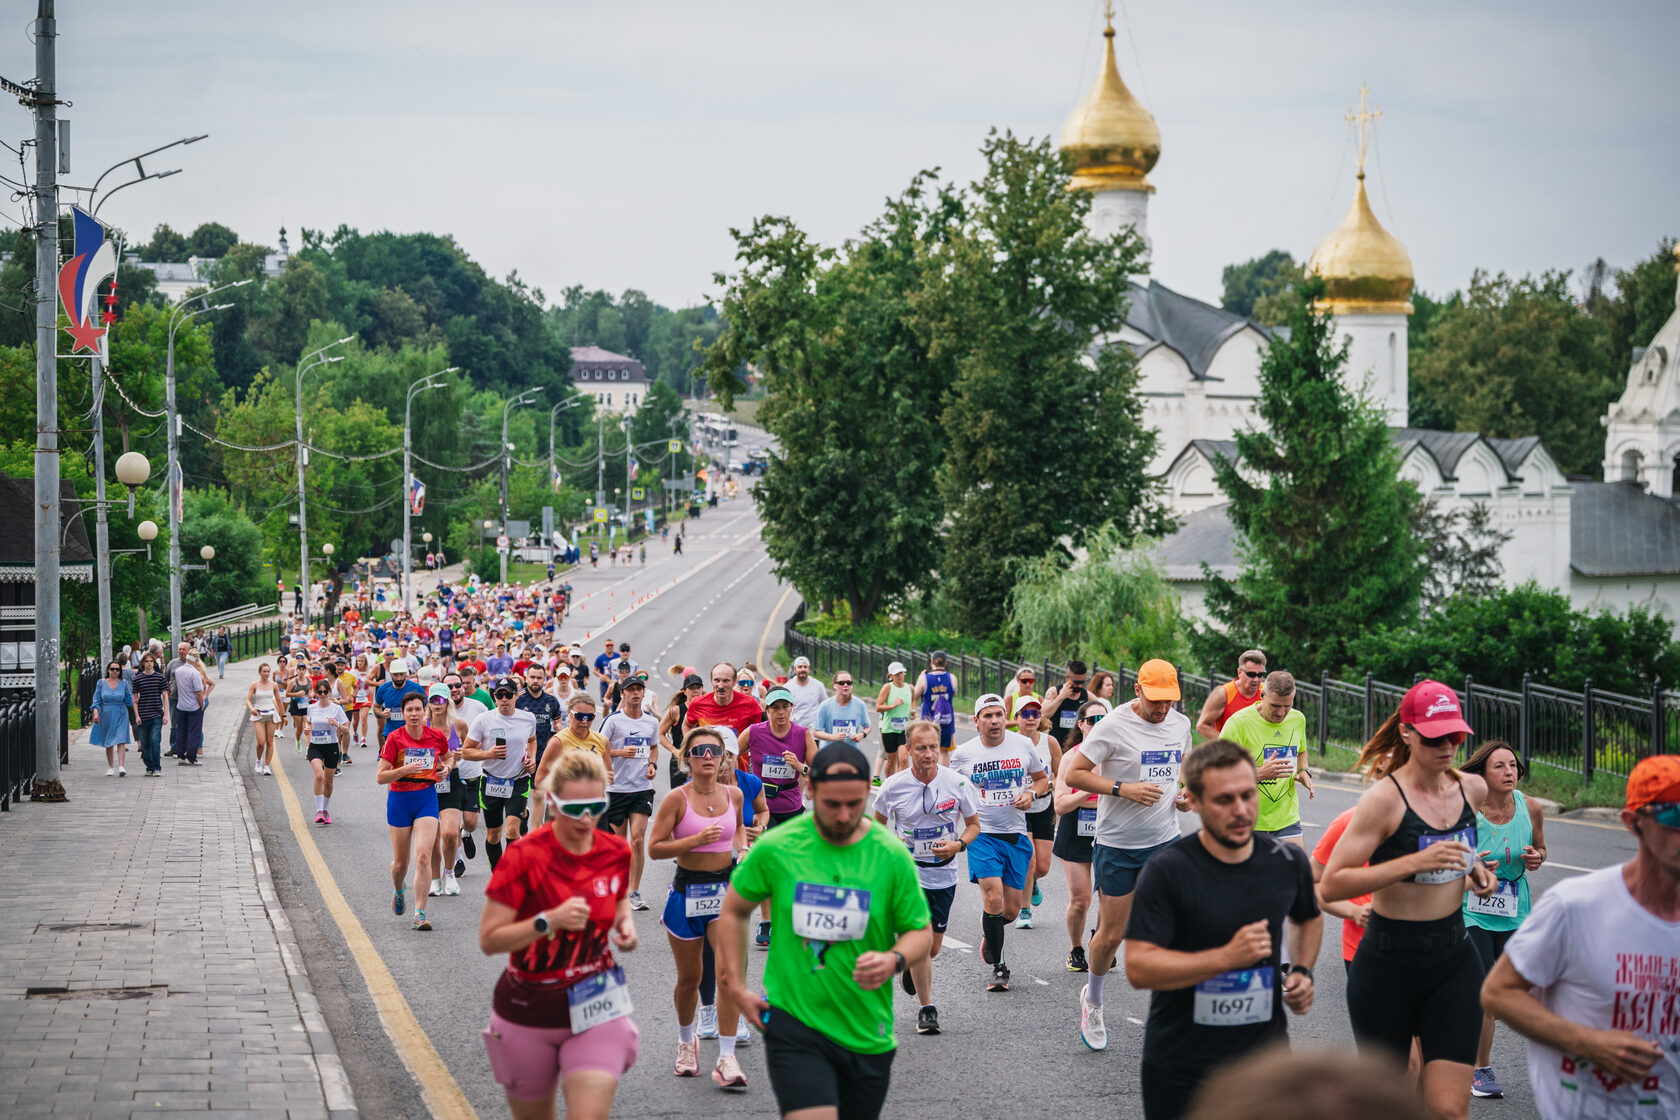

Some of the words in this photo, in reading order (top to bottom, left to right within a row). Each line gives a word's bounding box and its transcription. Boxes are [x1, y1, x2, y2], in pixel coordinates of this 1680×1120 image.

[769, 766, 788, 775] 1477
[1148, 766, 1172, 778] 1568
[992, 790, 1014, 801] 1733
[695, 898, 721, 911] 1522
[1478, 896, 1506, 909] 1278
[806, 911, 848, 931] 1784
[583, 996, 612, 1020] 1196
[1211, 996, 1255, 1016] 1697
